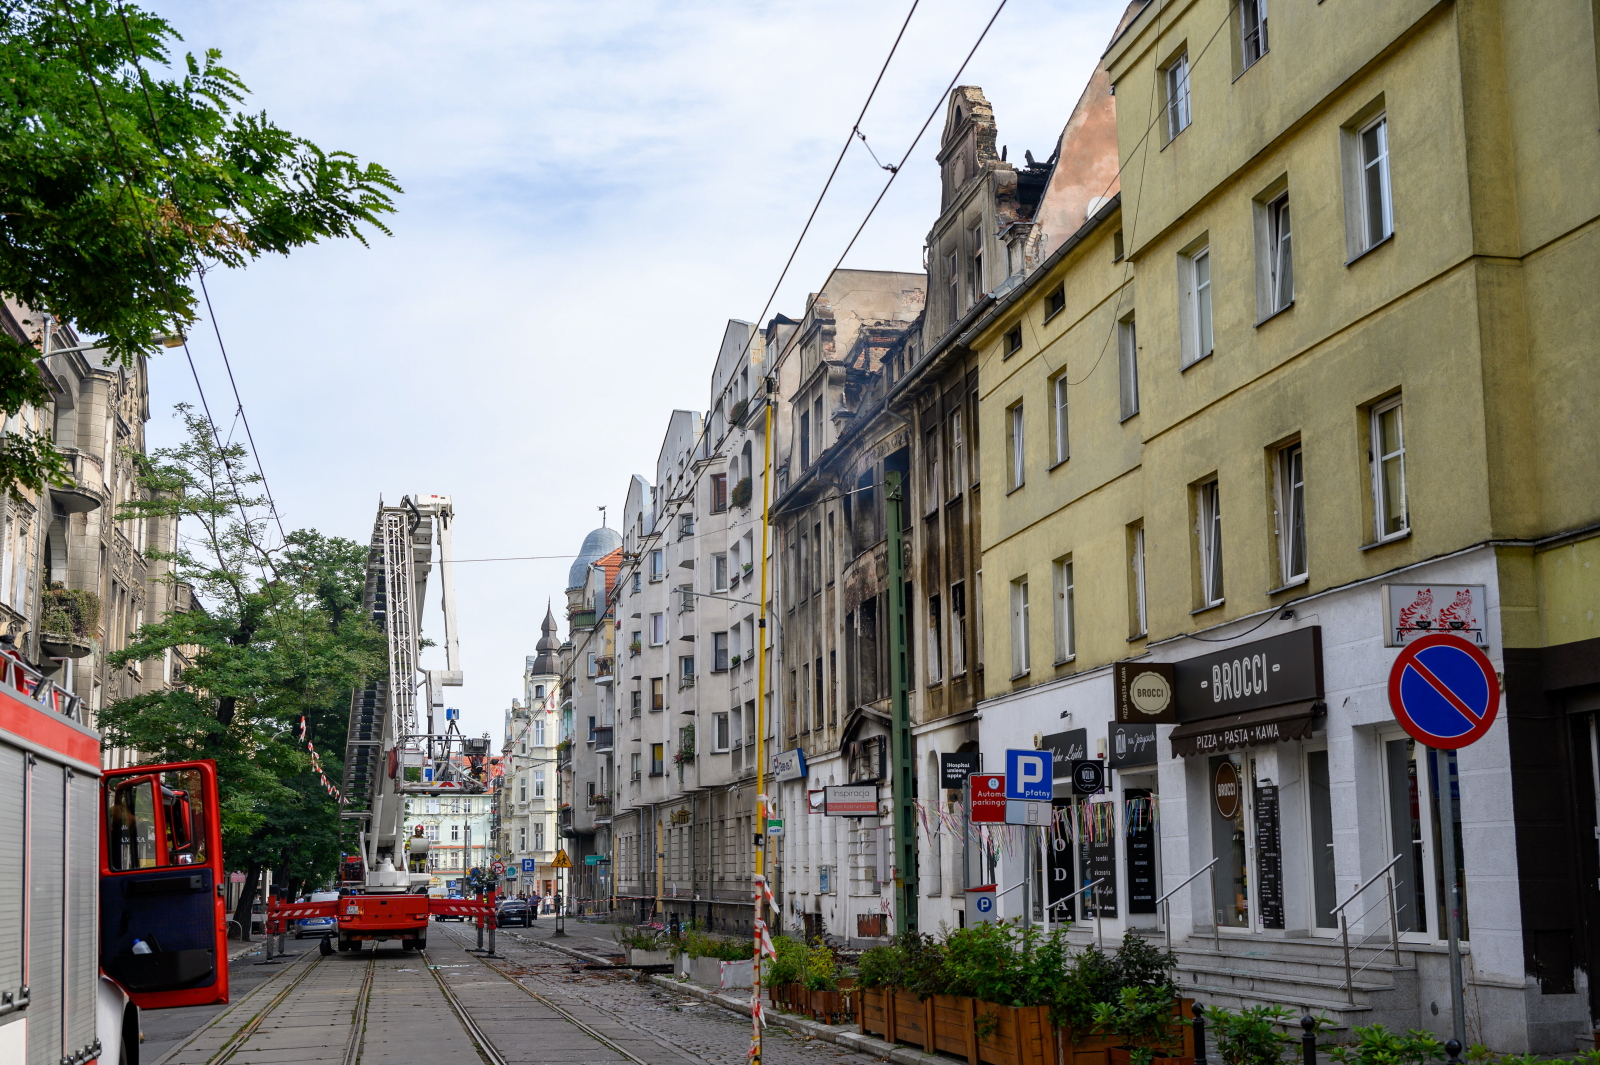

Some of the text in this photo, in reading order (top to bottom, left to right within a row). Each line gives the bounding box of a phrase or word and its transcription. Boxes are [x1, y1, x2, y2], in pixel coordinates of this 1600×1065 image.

[1212, 653, 1268, 703] BROCCI
[1137, 688, 1164, 698] BROCCI
[1196, 723, 1280, 750] PIZZA PASTA KAWA
[1017, 755, 1043, 793] P
[833, 789, 870, 799] Inspiracja
[977, 790, 1006, 798] Automa
[1025, 789, 1051, 799] płatny
[1217, 782, 1236, 797] BROCCI
[843, 803, 875, 811] Kosmetyczny
[972, 799, 1006, 808] parkingo
[524, 860, 532, 870] P
[981, 899, 989, 910] P
